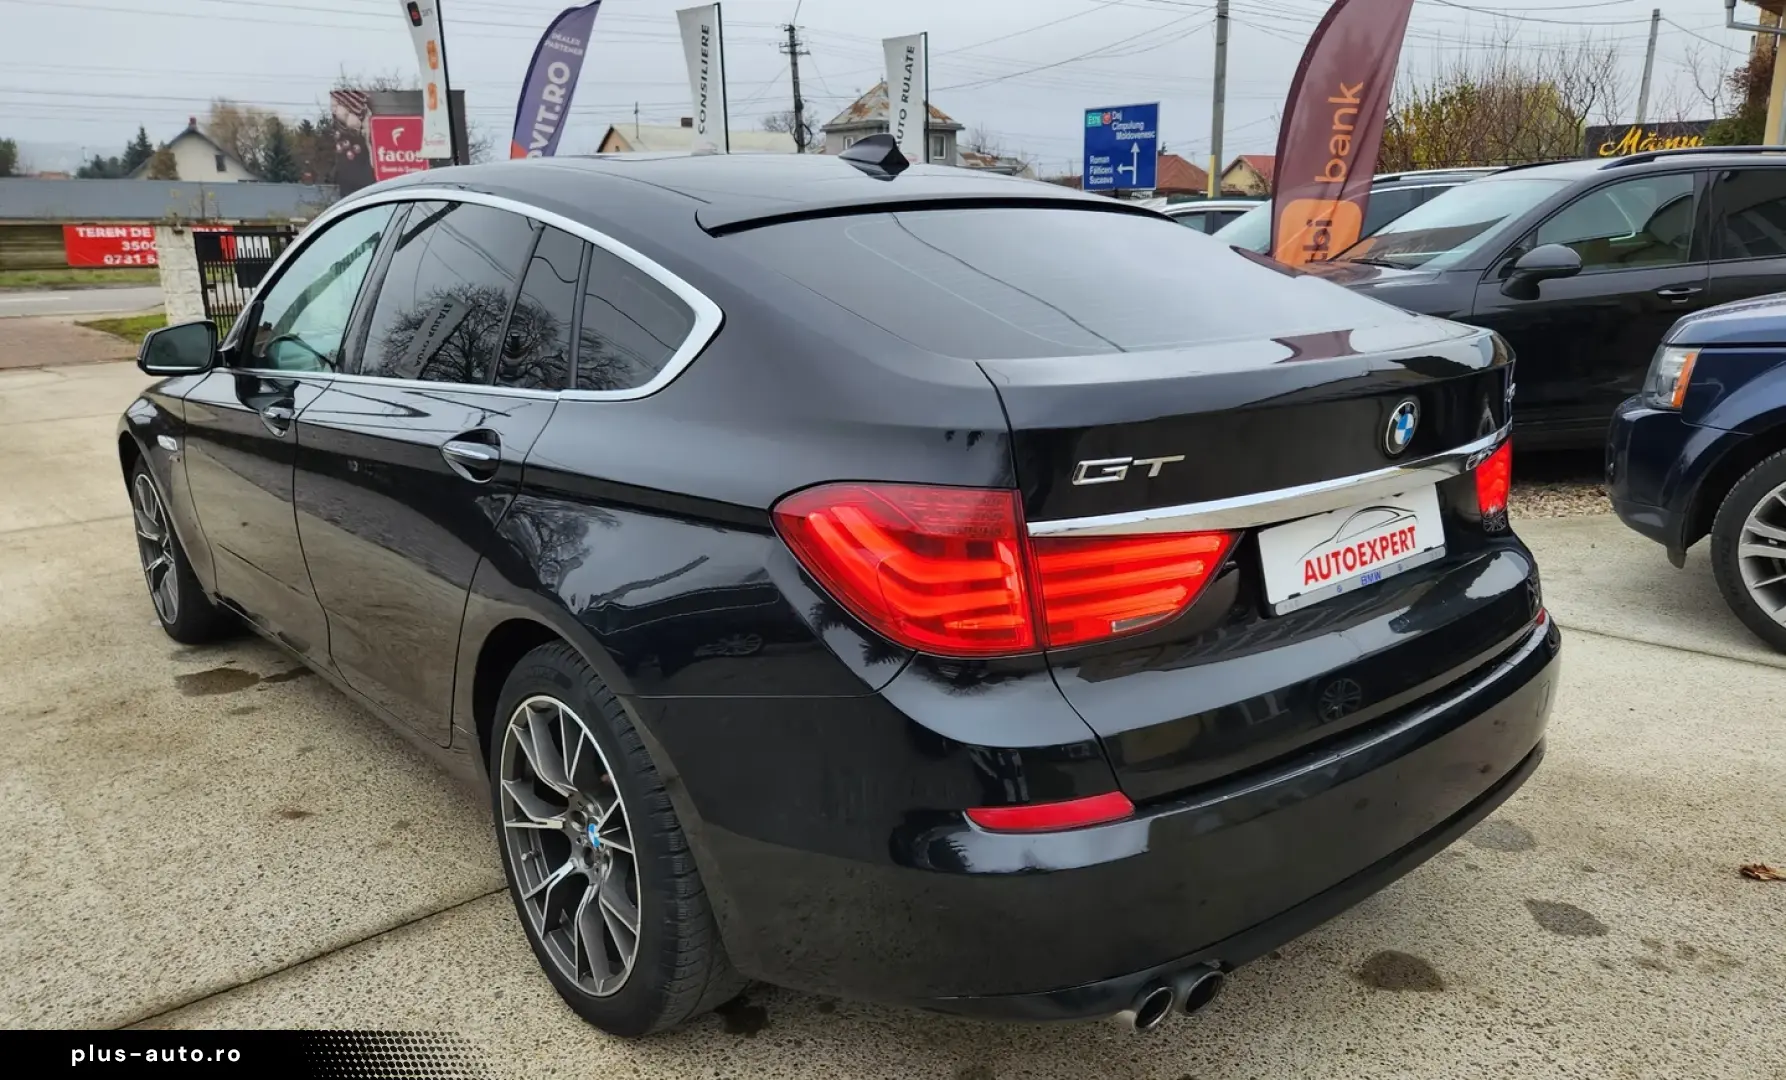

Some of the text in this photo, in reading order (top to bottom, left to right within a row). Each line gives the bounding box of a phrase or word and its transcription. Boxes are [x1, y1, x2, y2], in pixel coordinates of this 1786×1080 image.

[698, 25, 710, 135] CONSILIERE
[901, 45, 915, 104] RULATE
[1315, 81, 1364, 183] bank
[76, 227, 151, 238] TEREN DE
[104, 255, 141, 265] 0731
[1072, 455, 1186, 486] GT
[1303, 525, 1417, 586] AUTOEXPERT
[1361, 571, 1382, 586] BMW
